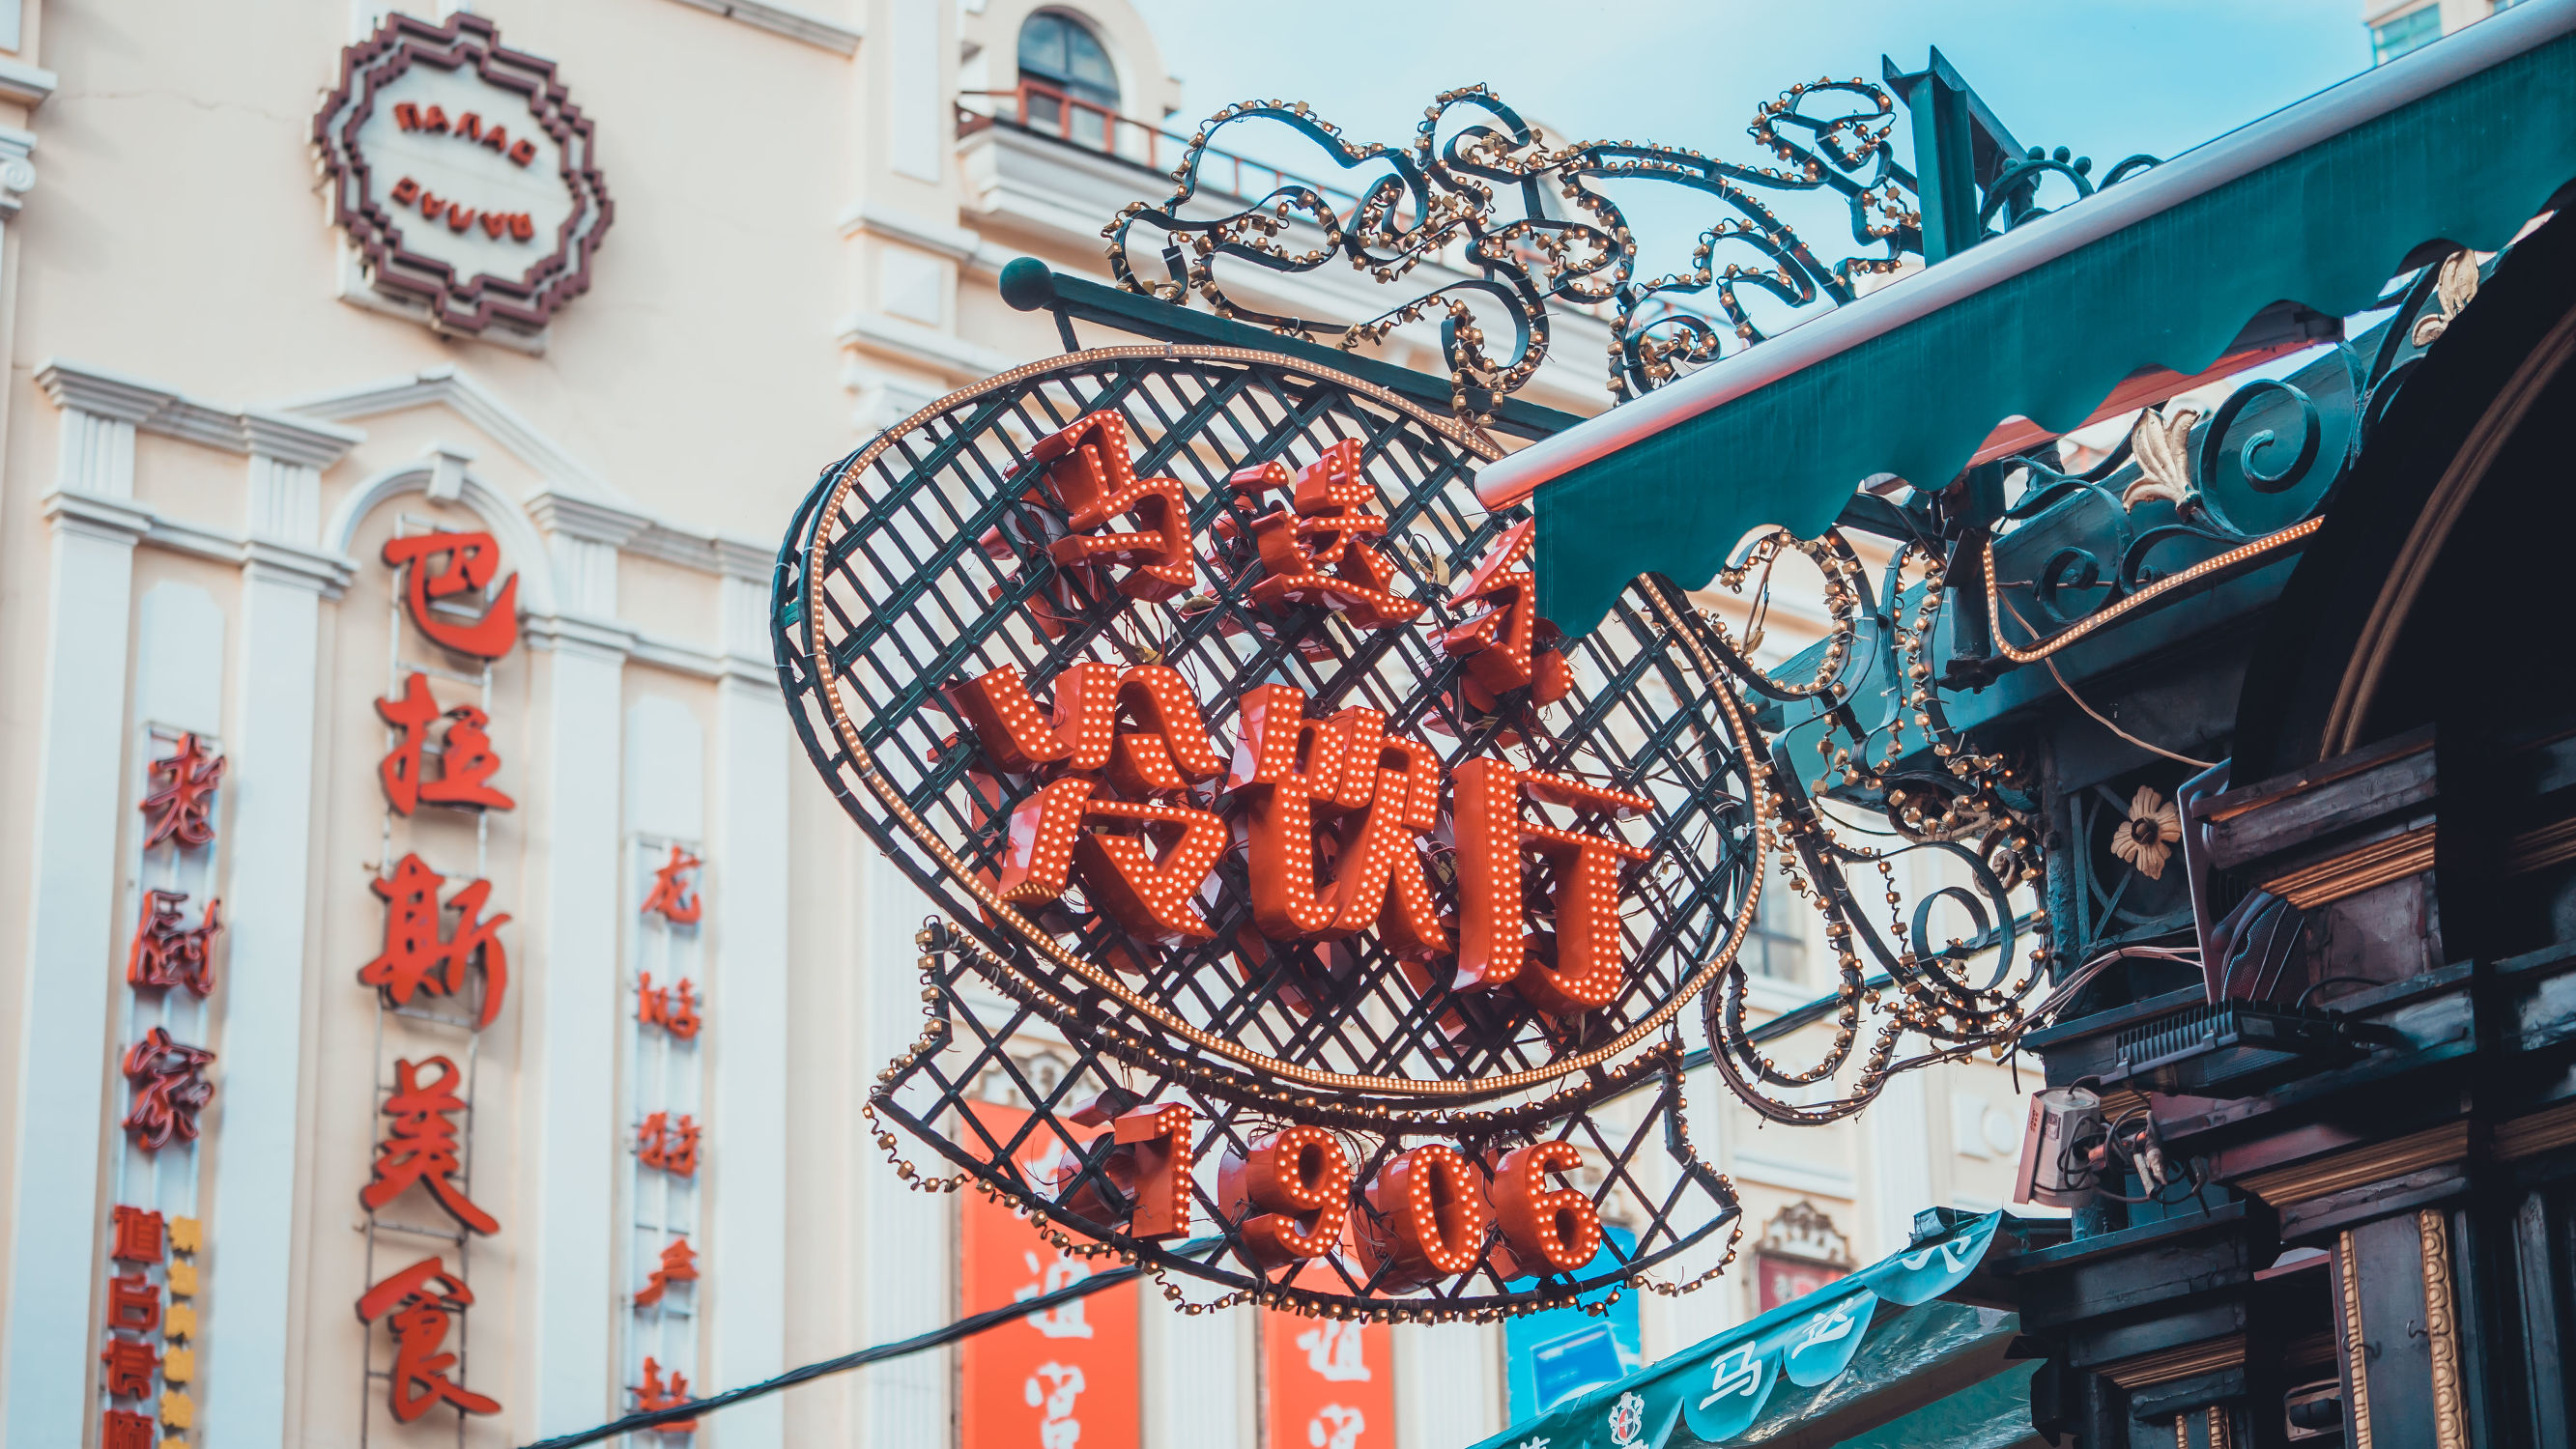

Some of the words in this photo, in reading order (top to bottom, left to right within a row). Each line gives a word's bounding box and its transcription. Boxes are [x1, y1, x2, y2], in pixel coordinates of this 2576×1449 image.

[123, 730, 227, 1153] 老厨家
[356, 530, 523, 1424] 巴拉斯美食
[1114, 1100, 1603, 1289] 1906
